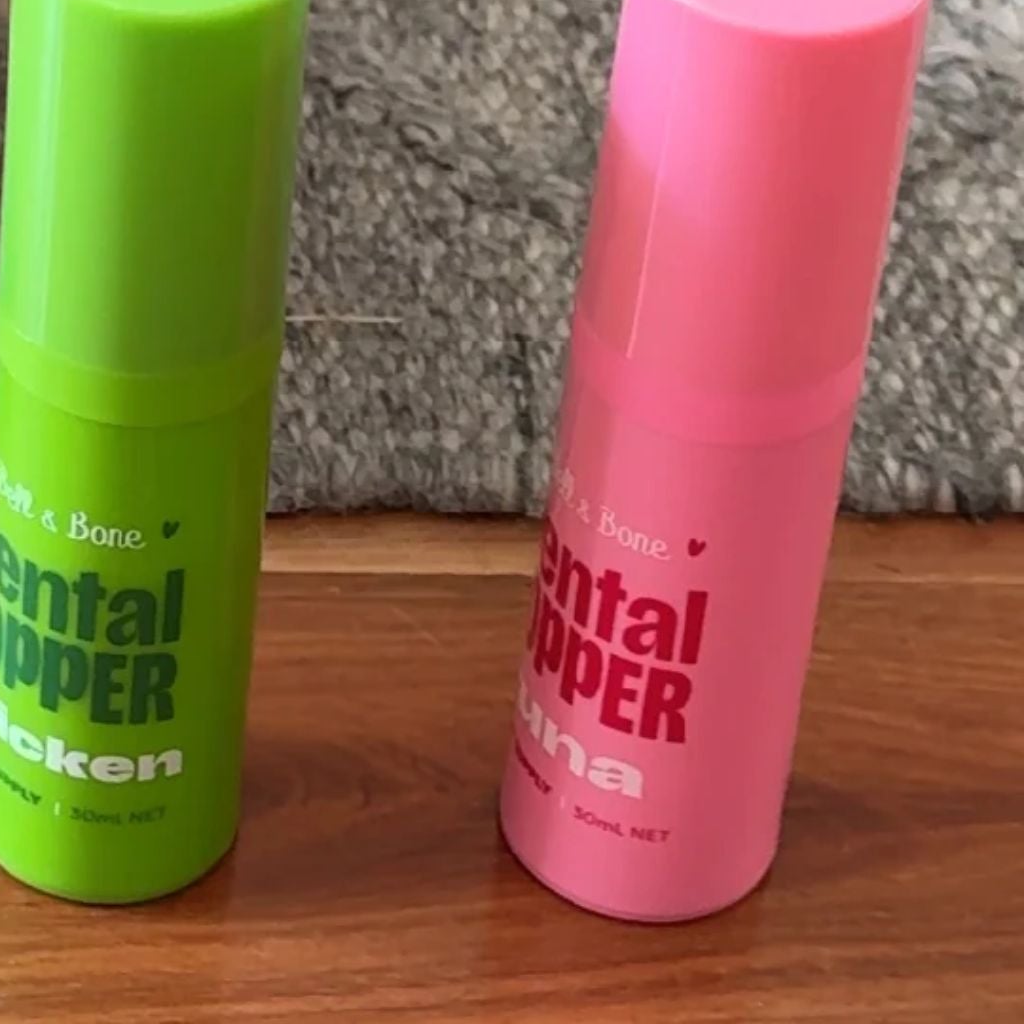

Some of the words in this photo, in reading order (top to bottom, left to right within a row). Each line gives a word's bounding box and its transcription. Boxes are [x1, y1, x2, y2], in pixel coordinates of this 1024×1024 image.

[41, 508, 57, 533] &
[67, 511, 146, 549] Bone
[597, 505, 672, 560] Bone
[540, 516, 709, 665] ental
[519, 676, 644, 799] una
[128, 805, 166, 824] NET
[630, 826, 671, 843] NET
